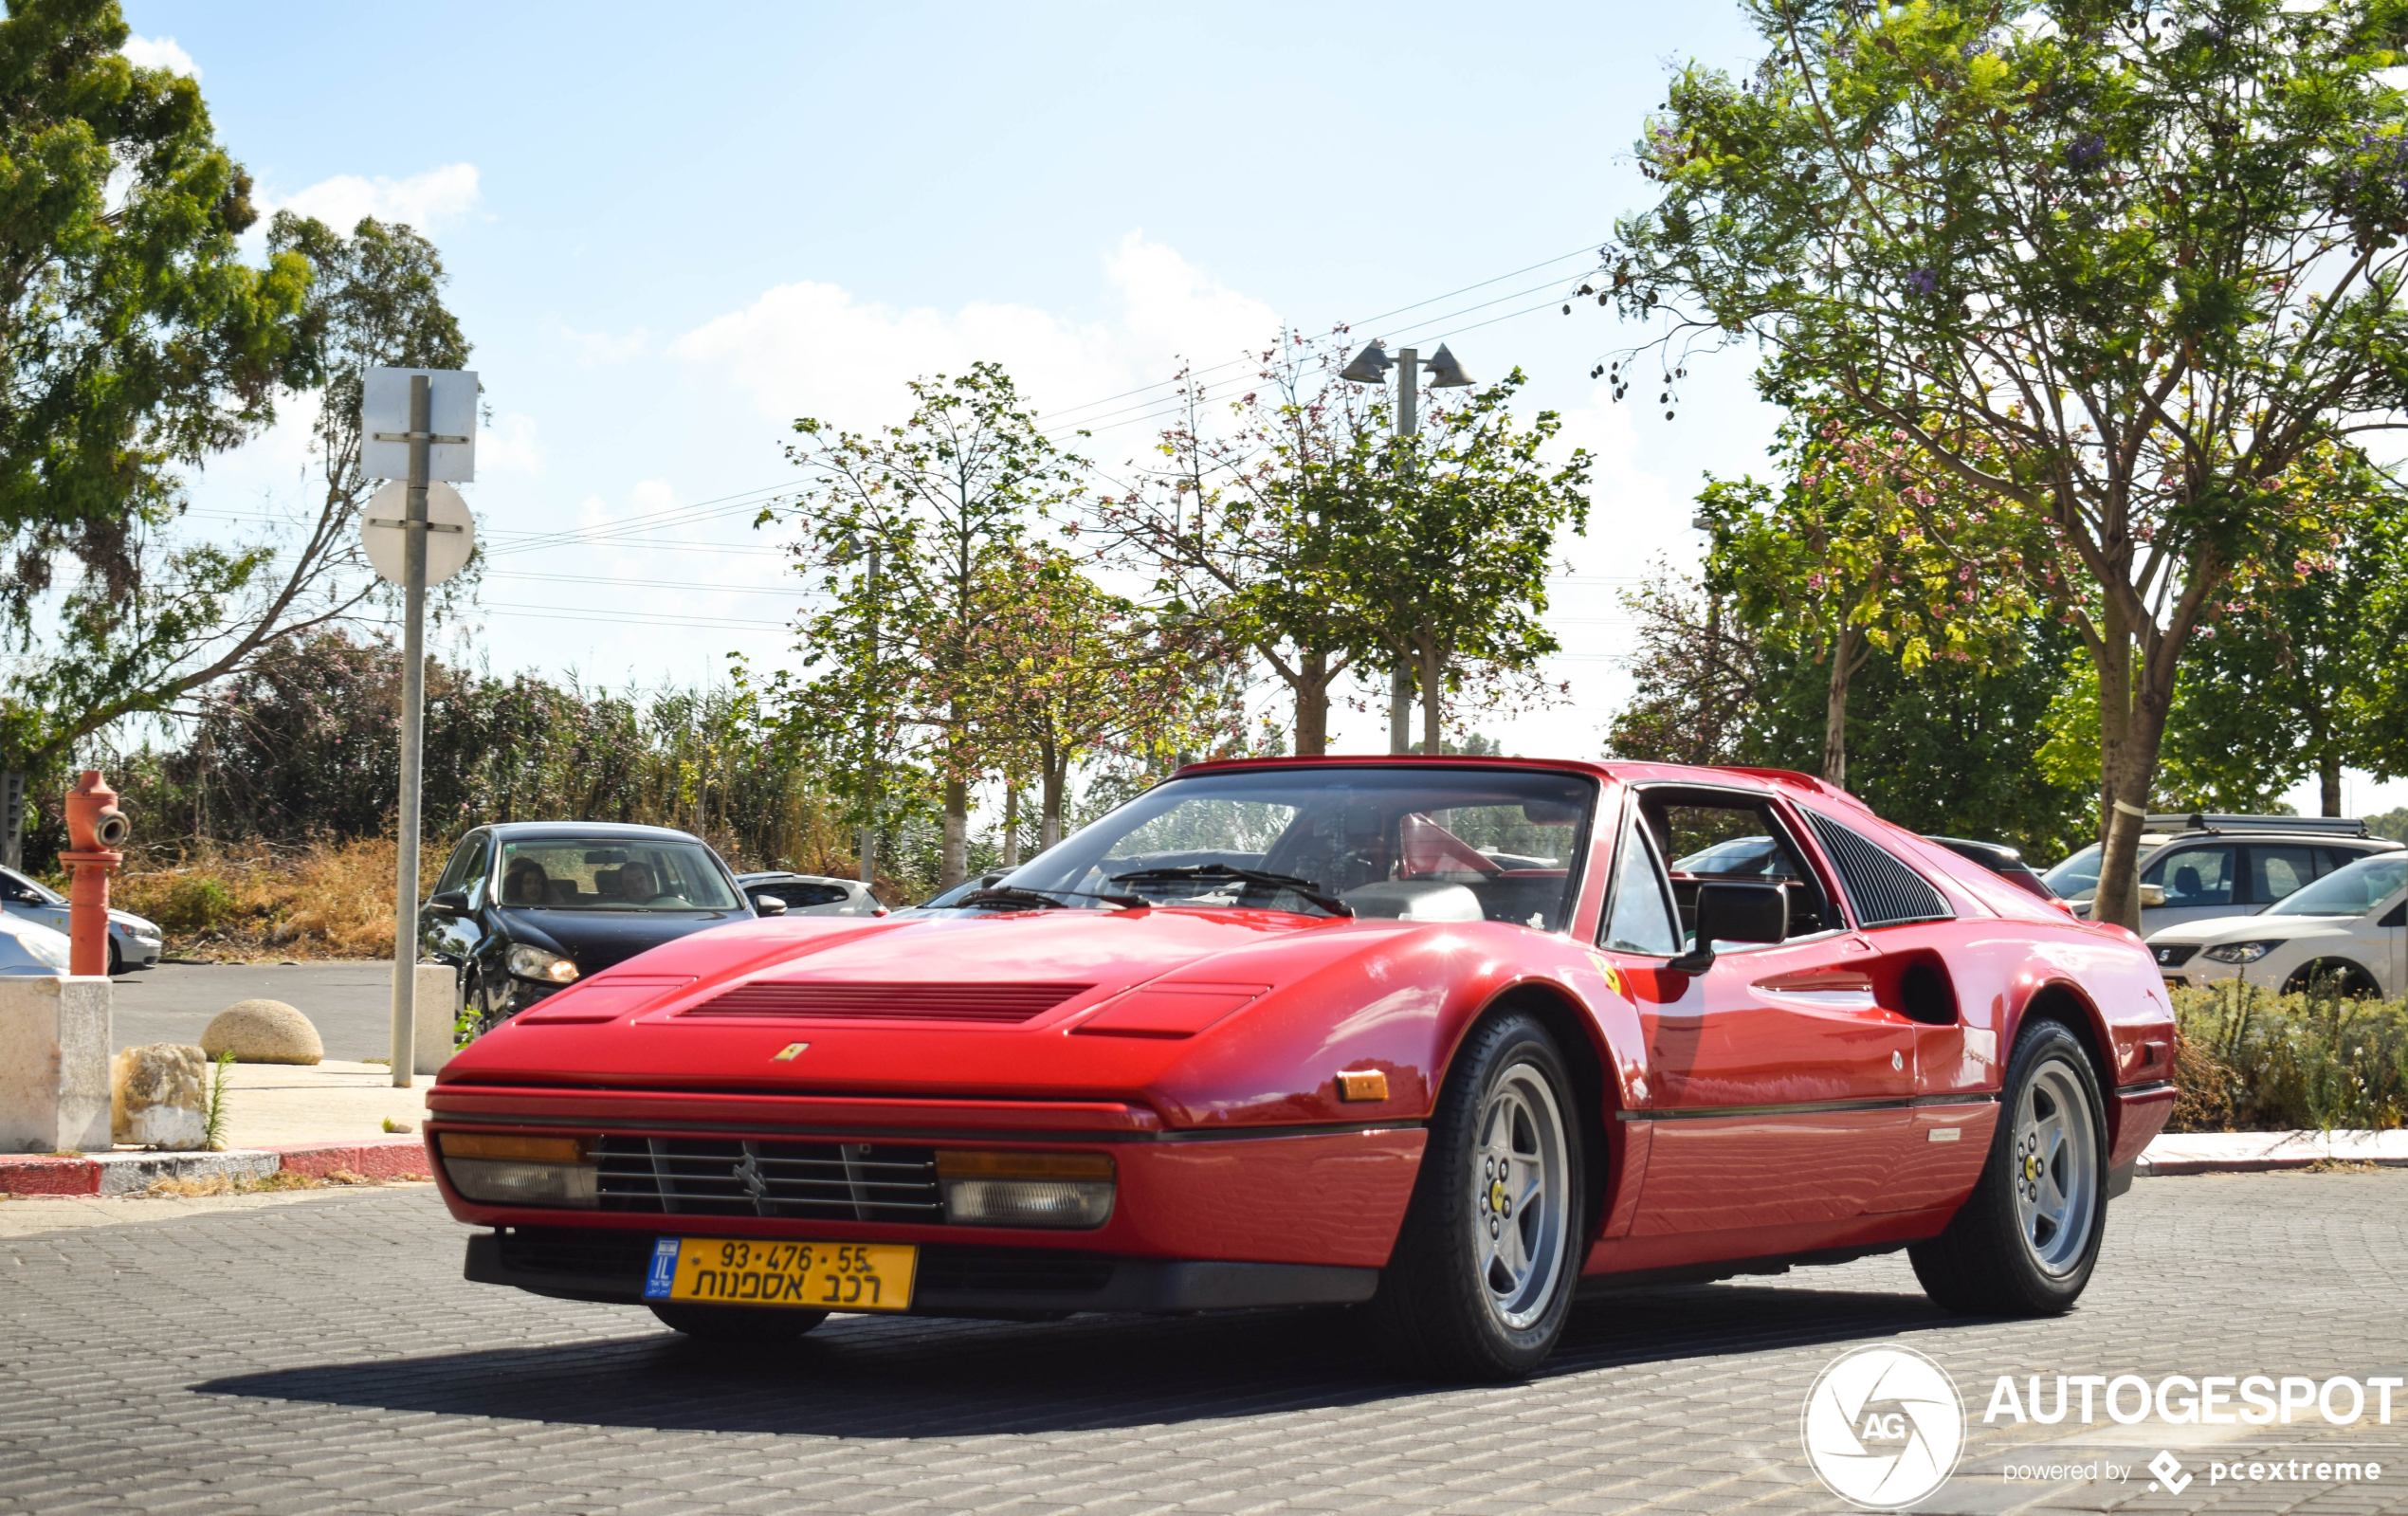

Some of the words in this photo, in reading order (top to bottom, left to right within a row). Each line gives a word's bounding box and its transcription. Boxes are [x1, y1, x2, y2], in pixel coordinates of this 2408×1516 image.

[654, 1255, 669, 1280] IL
[691, 1269, 806, 1300] אספנות
[822, 1273, 881, 1303] רכב
